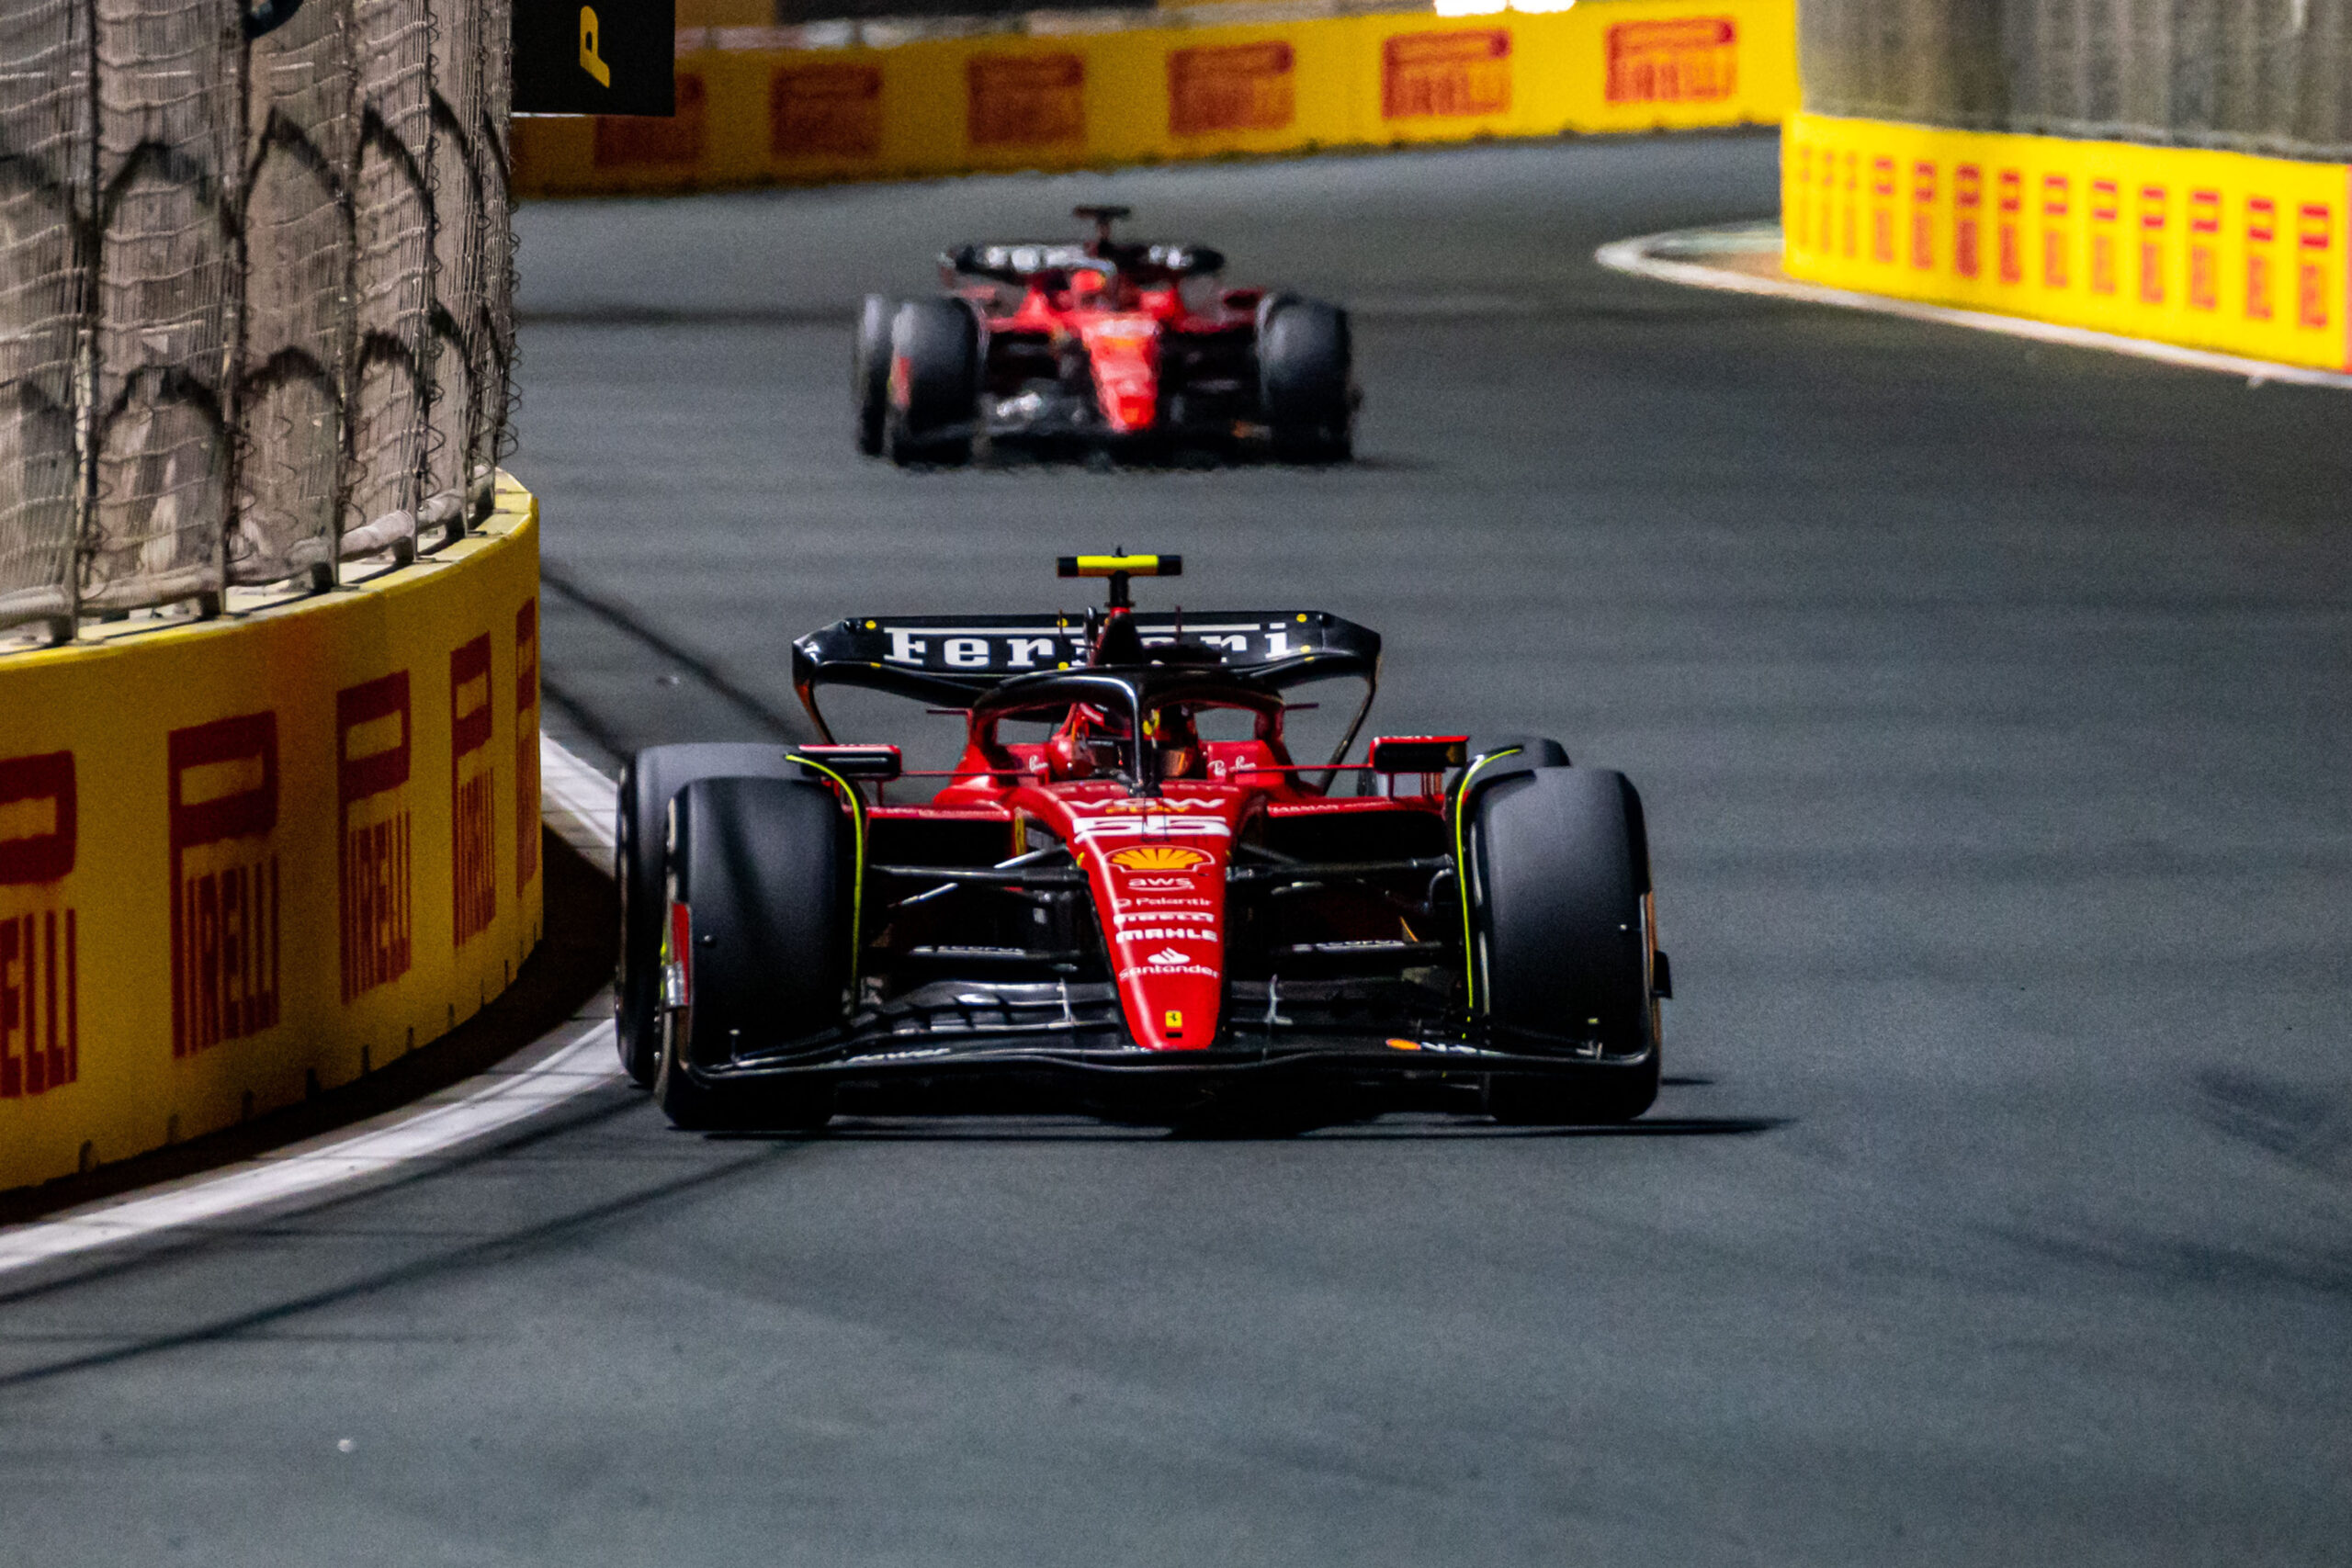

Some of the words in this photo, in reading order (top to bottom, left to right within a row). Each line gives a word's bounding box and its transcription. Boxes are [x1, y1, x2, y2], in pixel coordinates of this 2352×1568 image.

[883, 622, 1291, 668] Ferri
[336, 668, 412, 1008] PIRELLI
[1072, 815, 1231, 843] 55
[168, 709, 279, 1060] PIRELLI
[1128, 877, 1193, 891] aws
[1136, 897, 1213, 907] Palantir
[1115, 929, 1218, 943] MAHLE
